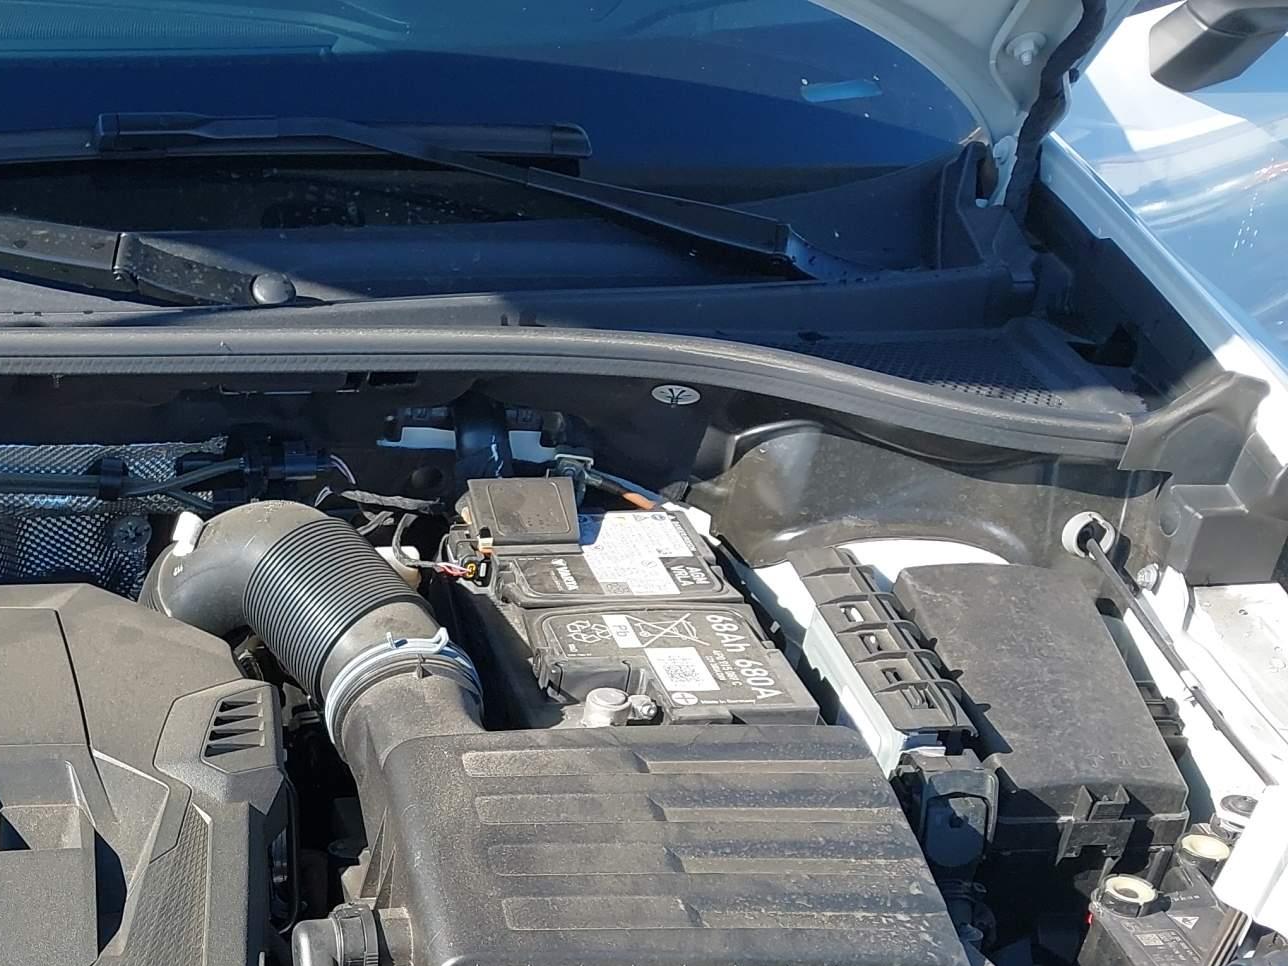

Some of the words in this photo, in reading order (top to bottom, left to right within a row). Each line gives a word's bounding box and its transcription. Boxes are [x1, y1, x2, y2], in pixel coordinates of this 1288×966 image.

[557, 567, 579, 592] VARTA
[670, 565, 695, 587] VRLA
[686, 567, 711, 585] AGM
[613, 624, 628, 638] Pb
[706, 614, 750, 652] 68Ah
[734, 658, 784, 699] 680A
